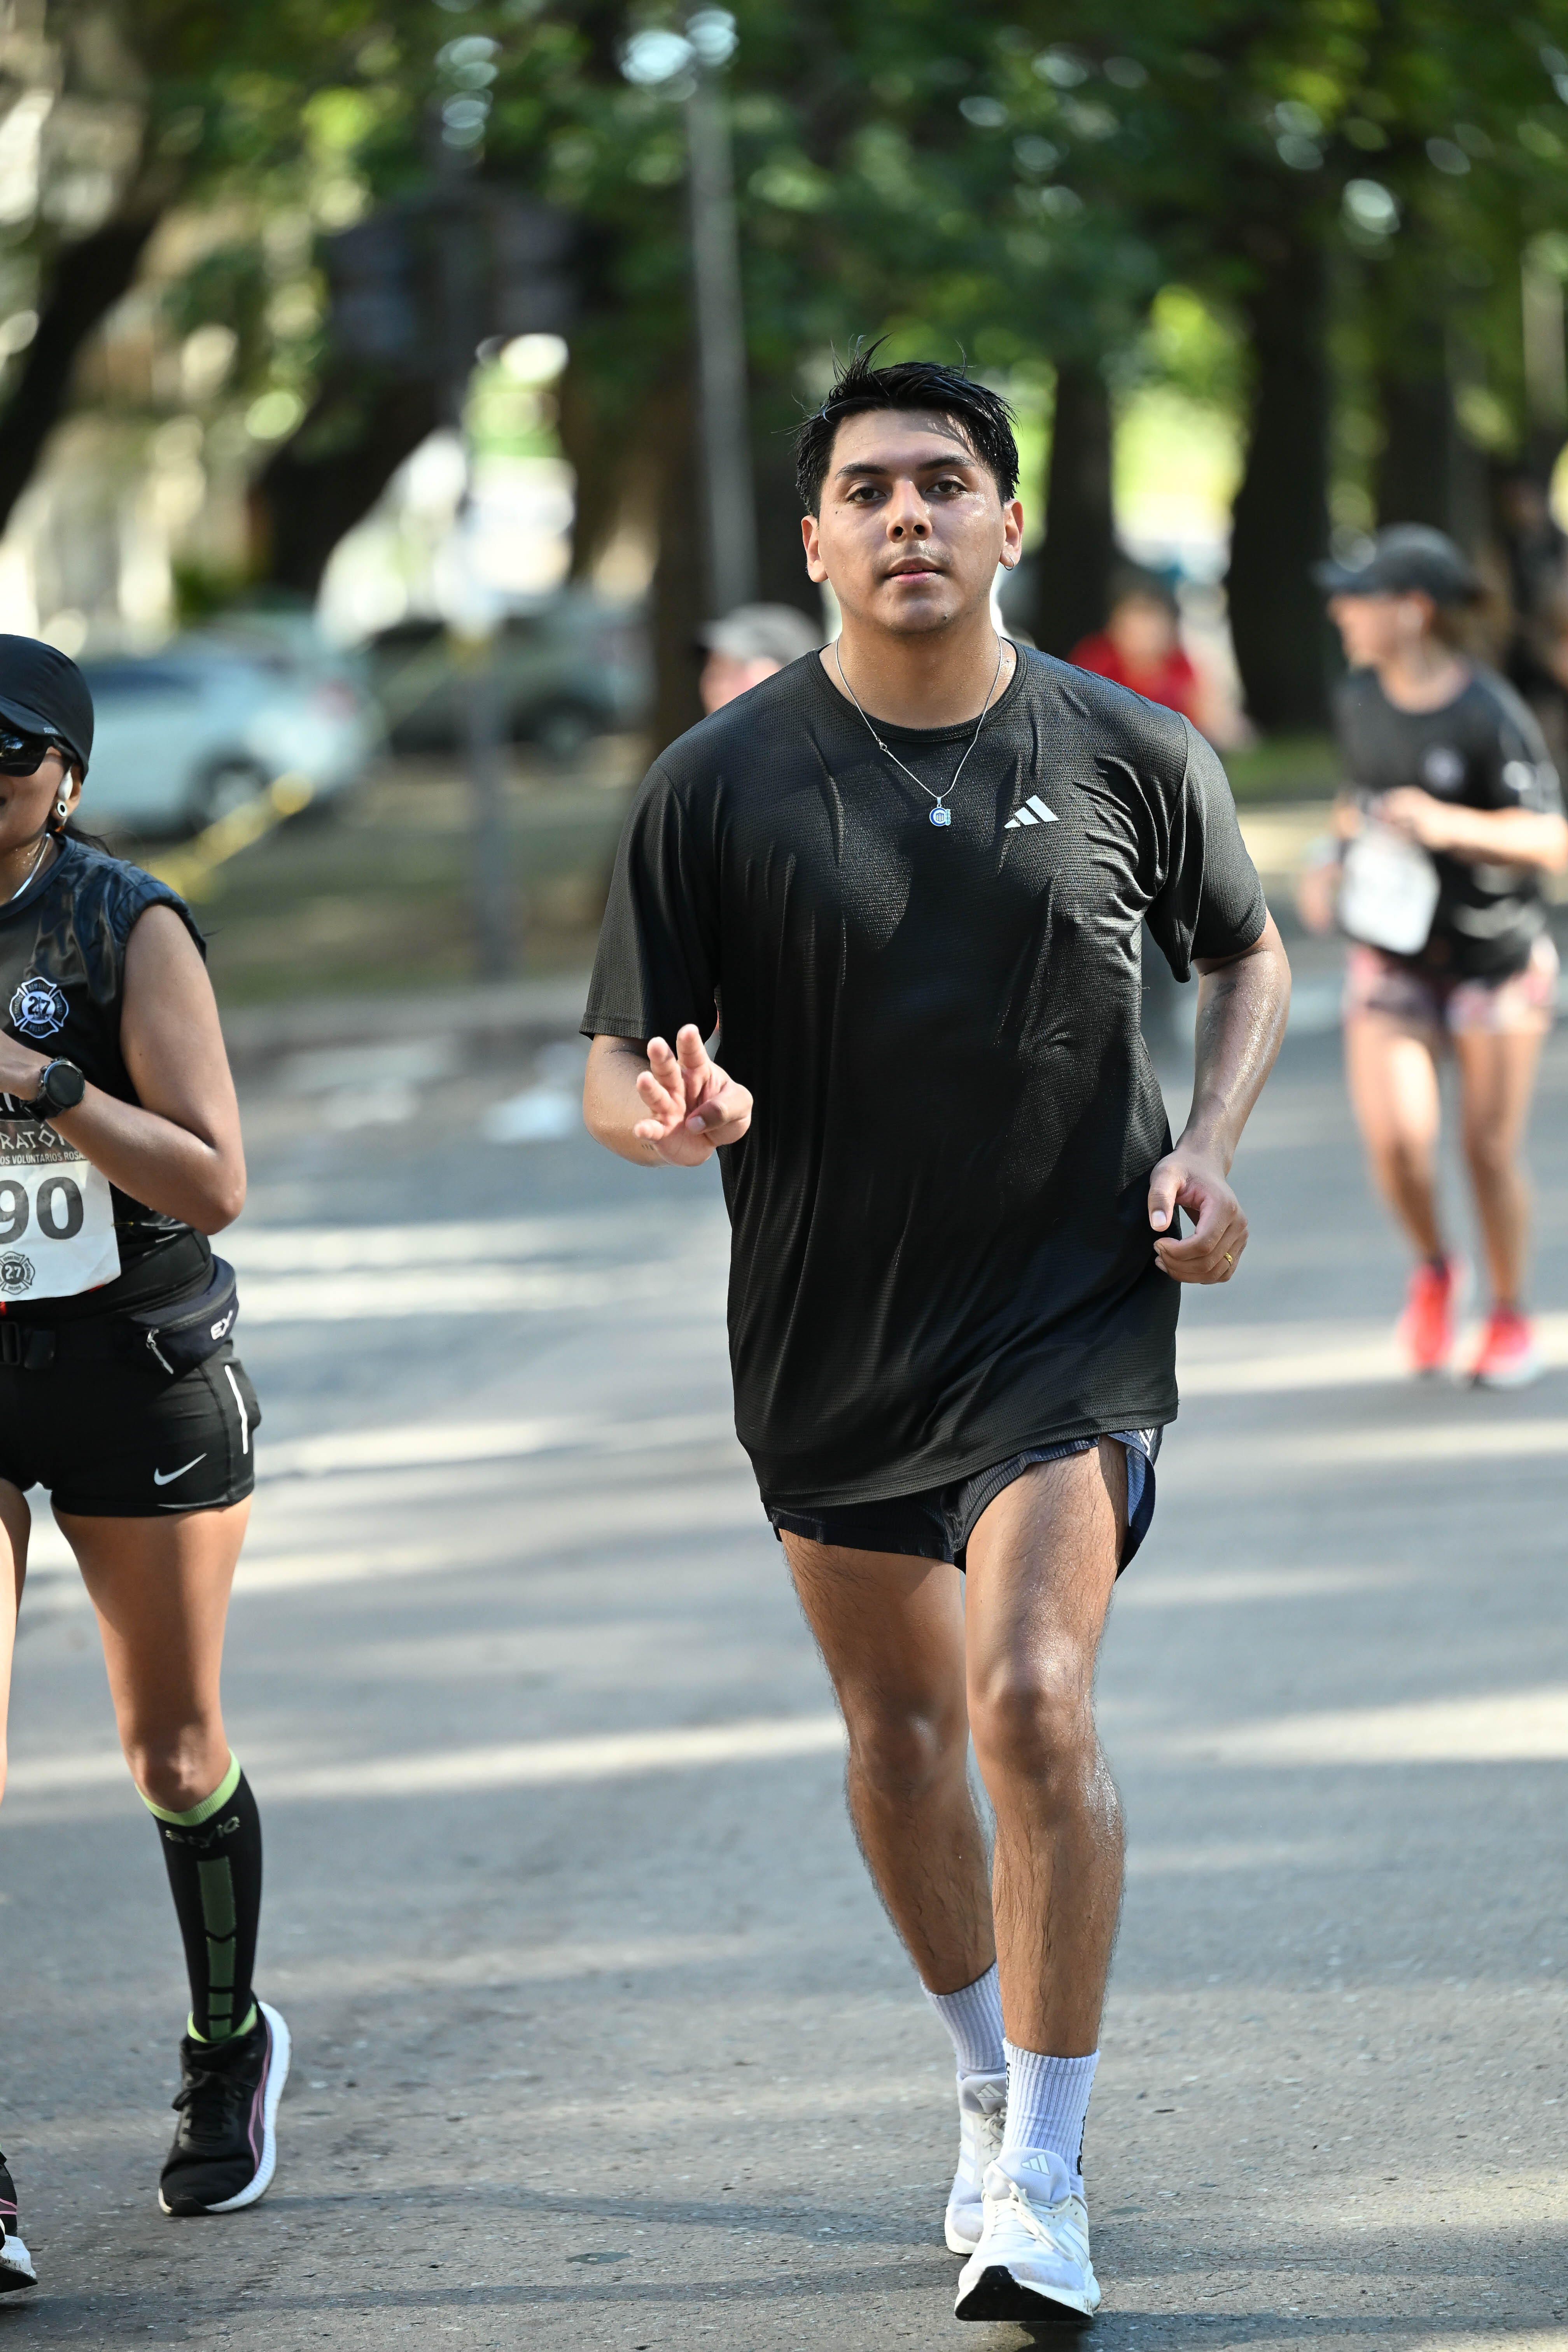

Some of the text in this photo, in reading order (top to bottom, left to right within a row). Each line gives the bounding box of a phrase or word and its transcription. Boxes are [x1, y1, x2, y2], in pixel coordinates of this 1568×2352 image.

[28, 996, 51, 1015] 27
[12, 1152, 62, 1164] VOLUNTARIOS
[63, 1150, 88, 1160] ROSA
[0, 1177, 84, 1244] 90
[5, 1264, 21, 1280] 27
